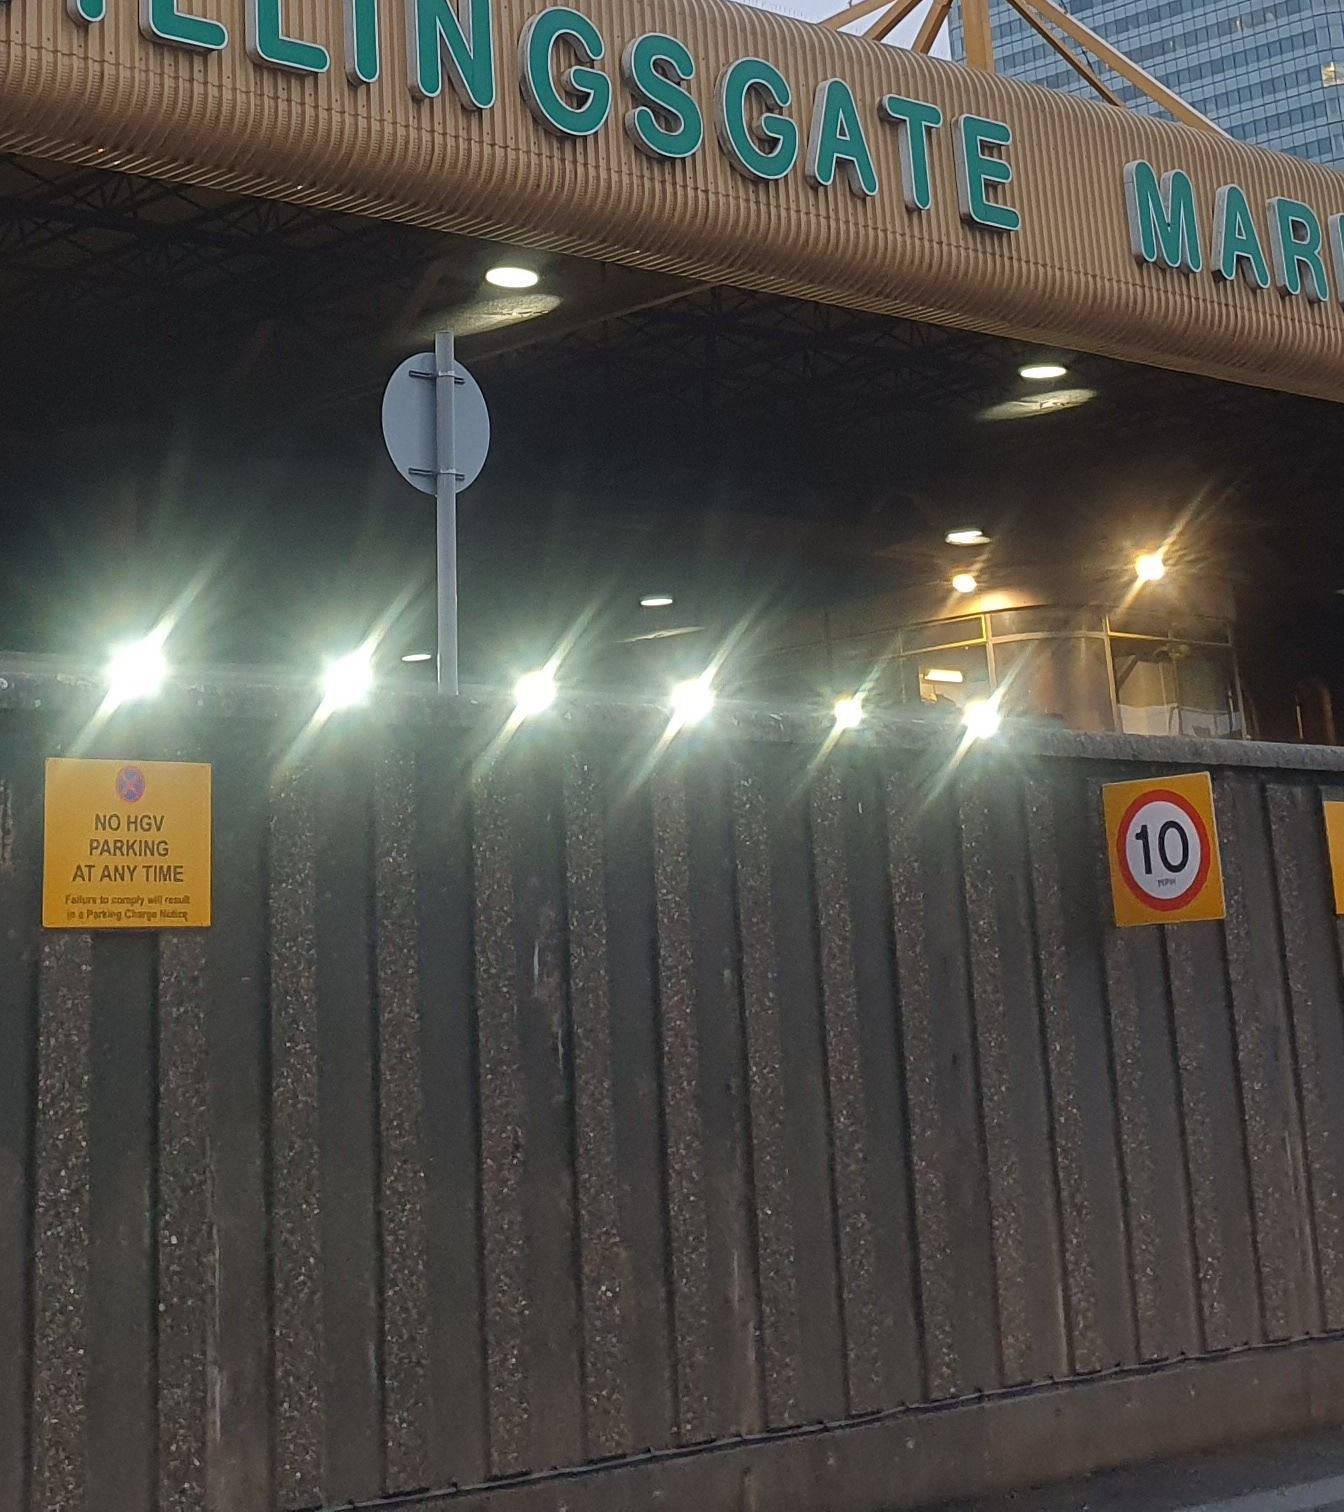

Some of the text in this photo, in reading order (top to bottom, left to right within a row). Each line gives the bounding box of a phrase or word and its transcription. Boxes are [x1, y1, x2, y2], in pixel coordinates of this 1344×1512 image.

[94, 813, 165, 832] NO HGV
[89, 839, 169, 857] PARKING
[1135, 820, 1189, 875] 10
[72, 864, 184, 883] AT ANY TIME
[100, 895, 109, 904] to
[111, 895, 145, 907] comply
[86, 909, 122, 921] Parking
[124, 909, 157, 921] Charge
